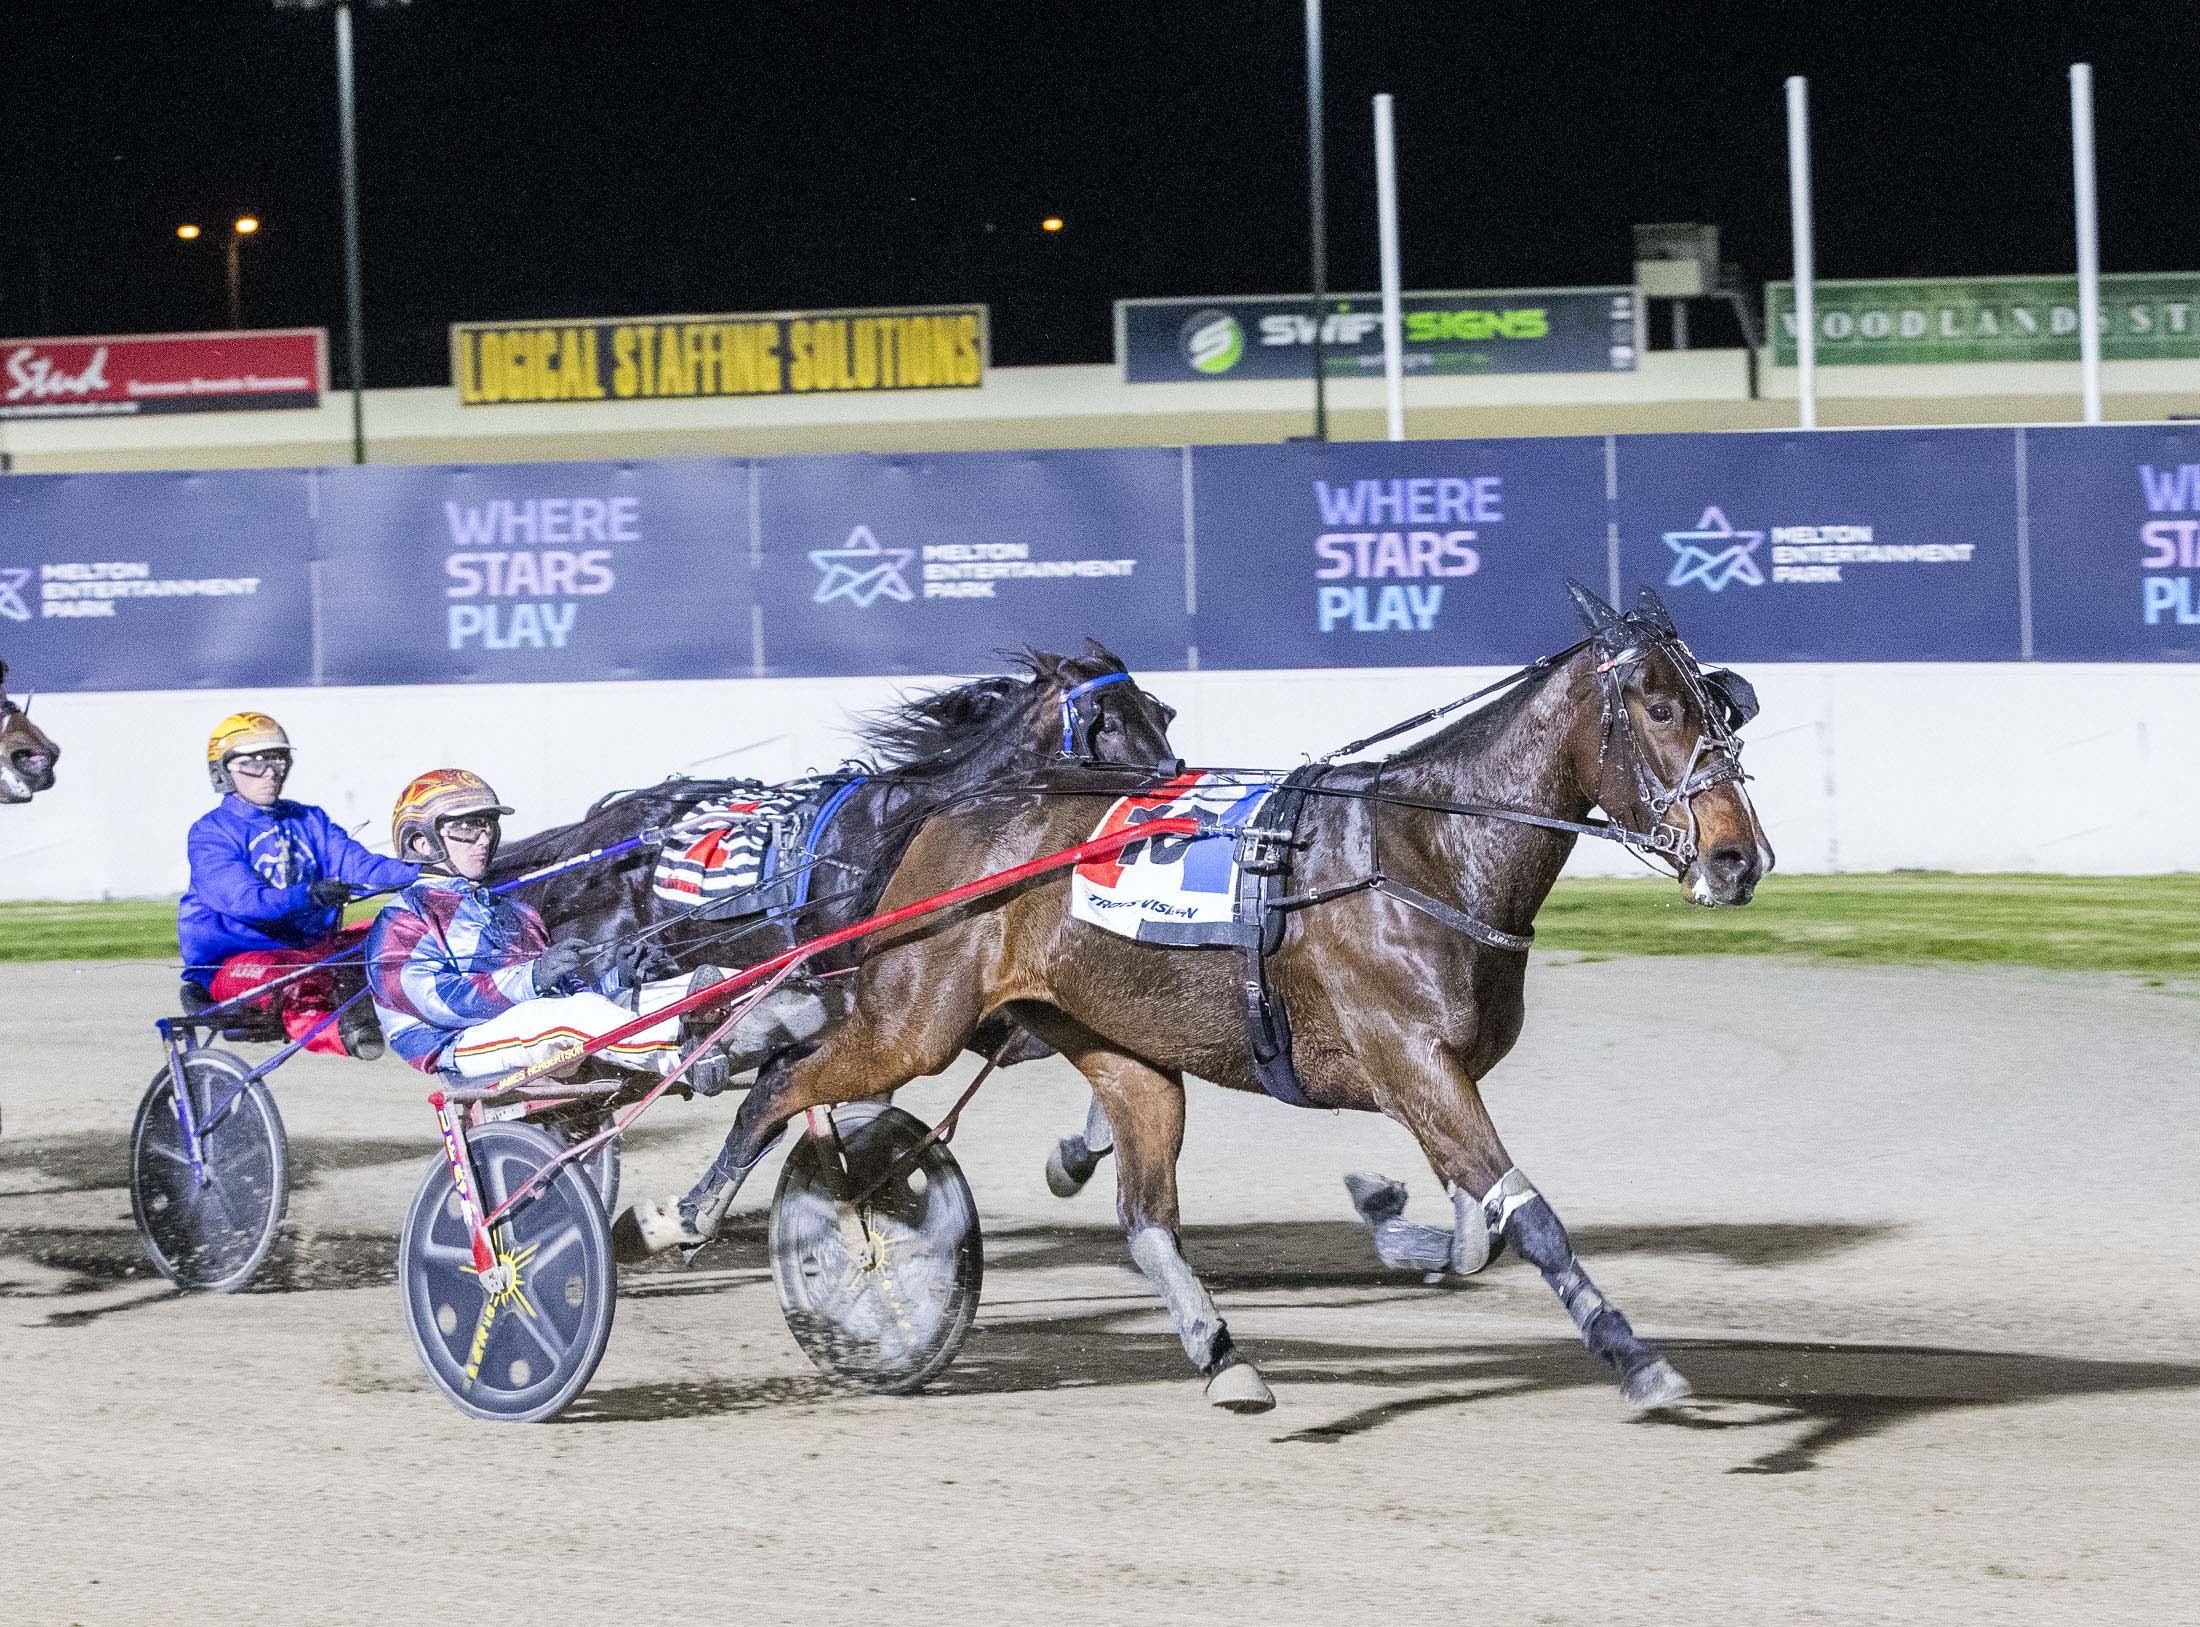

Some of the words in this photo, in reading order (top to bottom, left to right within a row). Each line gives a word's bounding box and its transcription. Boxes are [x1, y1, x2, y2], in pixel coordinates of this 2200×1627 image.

[462, 327, 606, 403] LOGICAL
[612, 321, 780, 397] STAFFING
[790, 314, 982, 392] SOLUTIONS
[1313, 476, 1504, 525] WHERE
[445, 496, 643, 546] WHERE
[1771, 525, 1873, 544] MELTON
[2142, 520, 2200, 569] ST
[922, 543, 1029, 561] MELTON
[1314, 530, 1480, 579] STARS
[1772, 543, 1976, 563] ENTERTAINMENT
[41, 561, 149, 580] MELTON
[444, 550, 615, 598] STARS
[922, 560, 1138, 580] ENTERTAINMENT
[1772, 565, 1842, 583] PARK
[42, 578, 260, 600] ENTERTAINMENT
[923, 581, 996, 598] PARK
[42, 599, 116, 618] PARK
[1317, 584, 1445, 633] PLAY
[448, 602, 578, 650] PLAY
